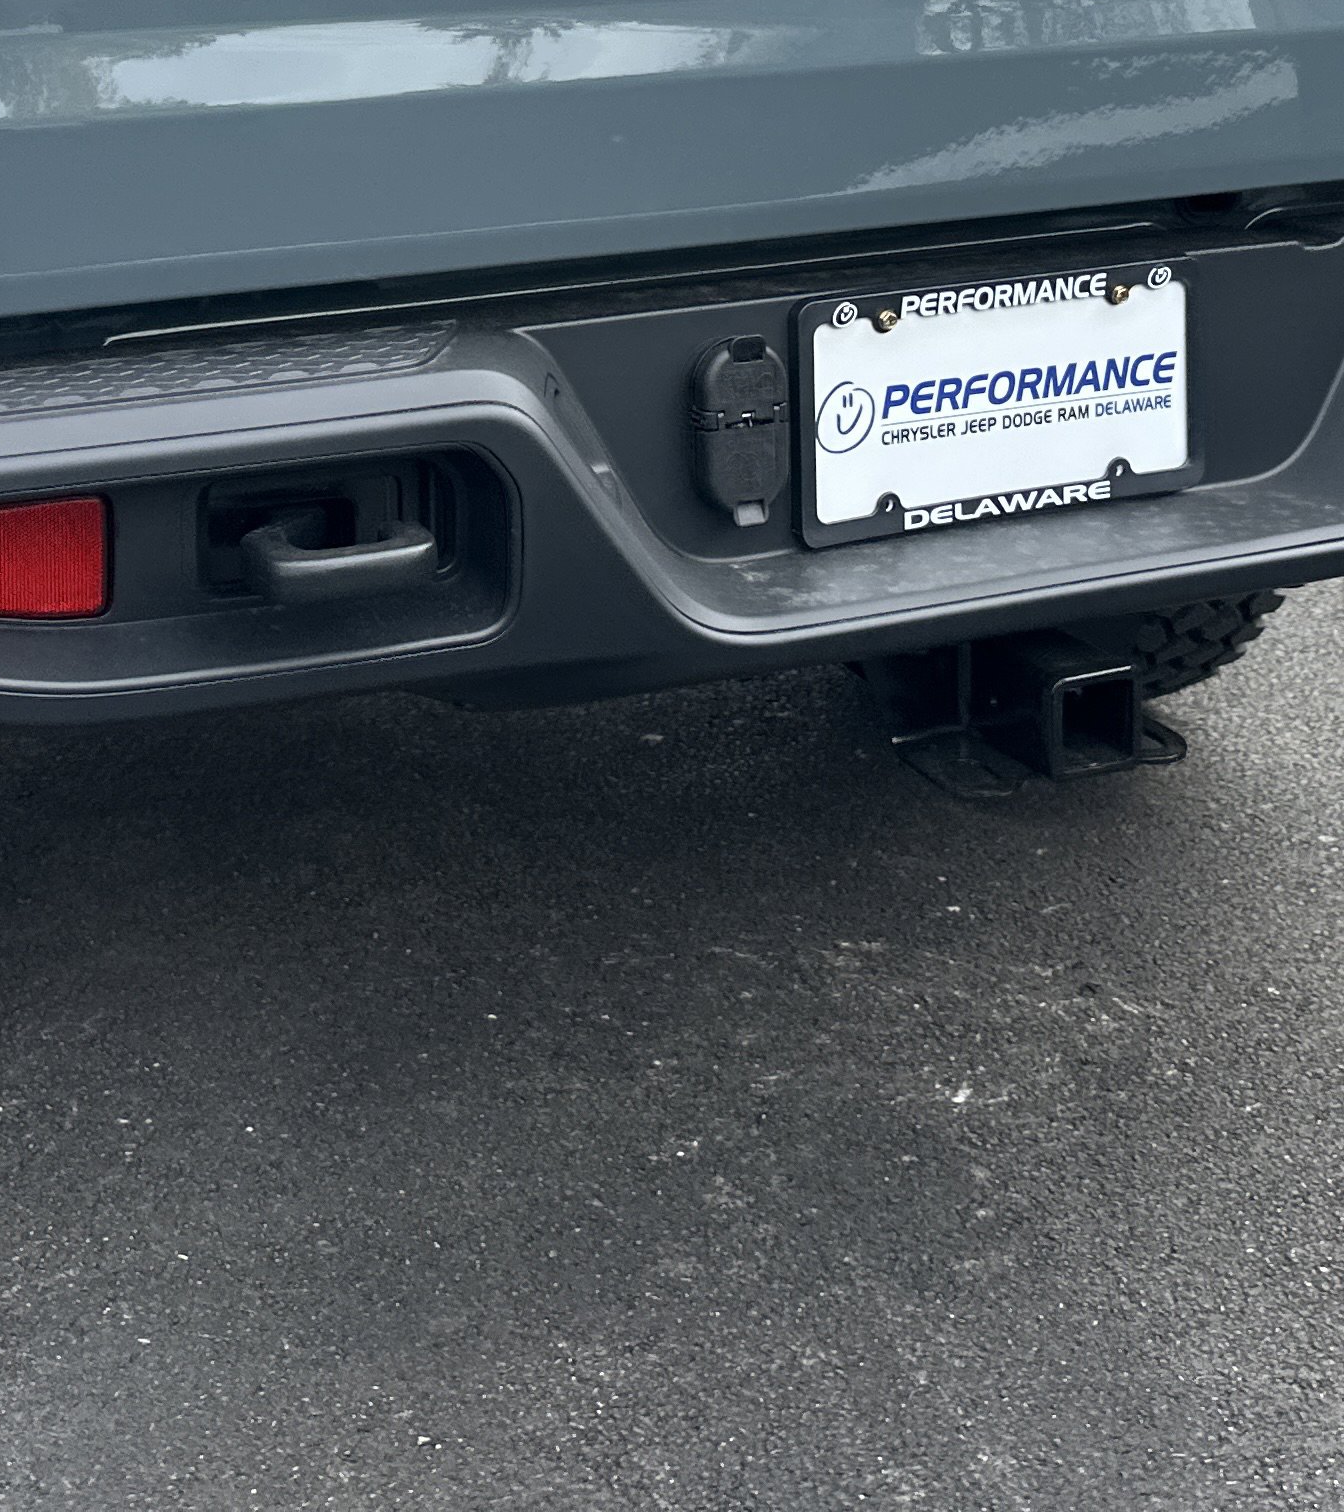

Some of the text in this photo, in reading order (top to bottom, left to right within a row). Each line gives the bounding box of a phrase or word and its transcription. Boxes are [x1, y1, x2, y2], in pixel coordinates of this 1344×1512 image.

[900, 272, 1108, 320] PERFORMANCE
[881, 350, 1178, 420] PERFORMANCE
[881, 394, 1172, 446] CHRYSLER JEEP DODGE RAM DELAWARE
[903, 480, 1112, 531] DELAWARE
